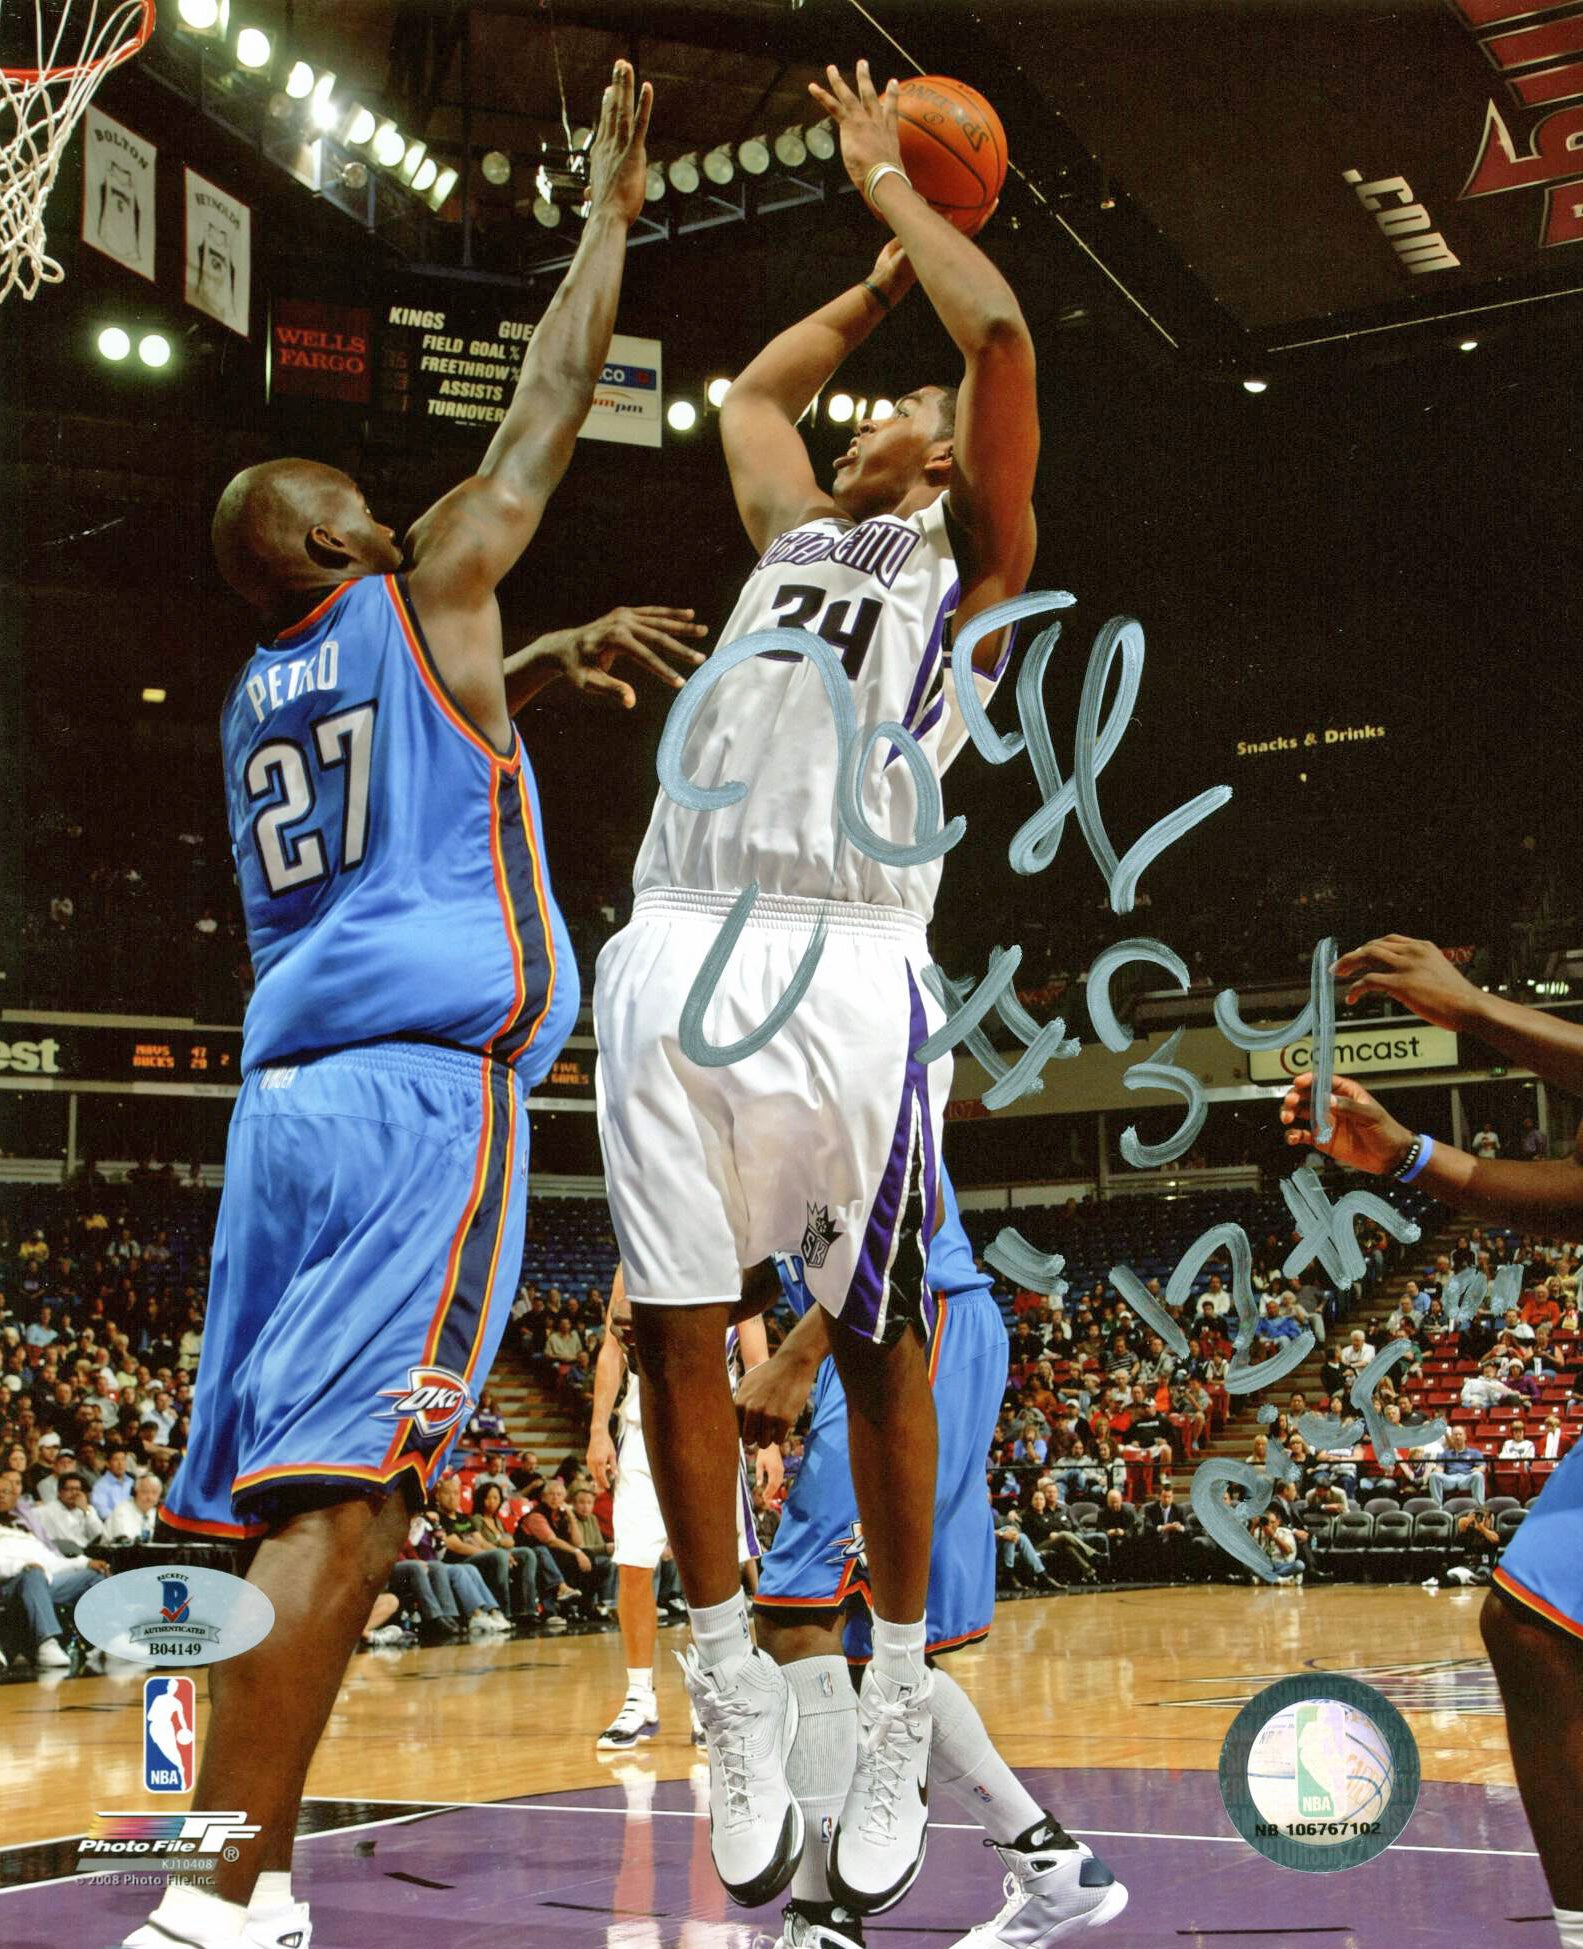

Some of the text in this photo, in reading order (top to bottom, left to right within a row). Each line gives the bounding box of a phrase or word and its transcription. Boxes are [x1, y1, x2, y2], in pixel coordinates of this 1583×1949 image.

[94, 129, 149, 170] BOLTON
[1342, 169, 1460, 274] .com
[389, 306, 535, 341] KINGS GUE
[276, 327, 367, 353] WELLS
[423, 335, 463, 353] FIELD
[279, 350, 365, 375] FARGO
[599, 367, 626, 382] CO
[439, 380, 503, 402] ASSISTS
[1237, 724, 1386, 756] Snacks & Drinks
[243, 698, 379, 899] 27
[132, 1056, 175, 1069] BUCKS
[397, 1386, 463, 1412] OKC
